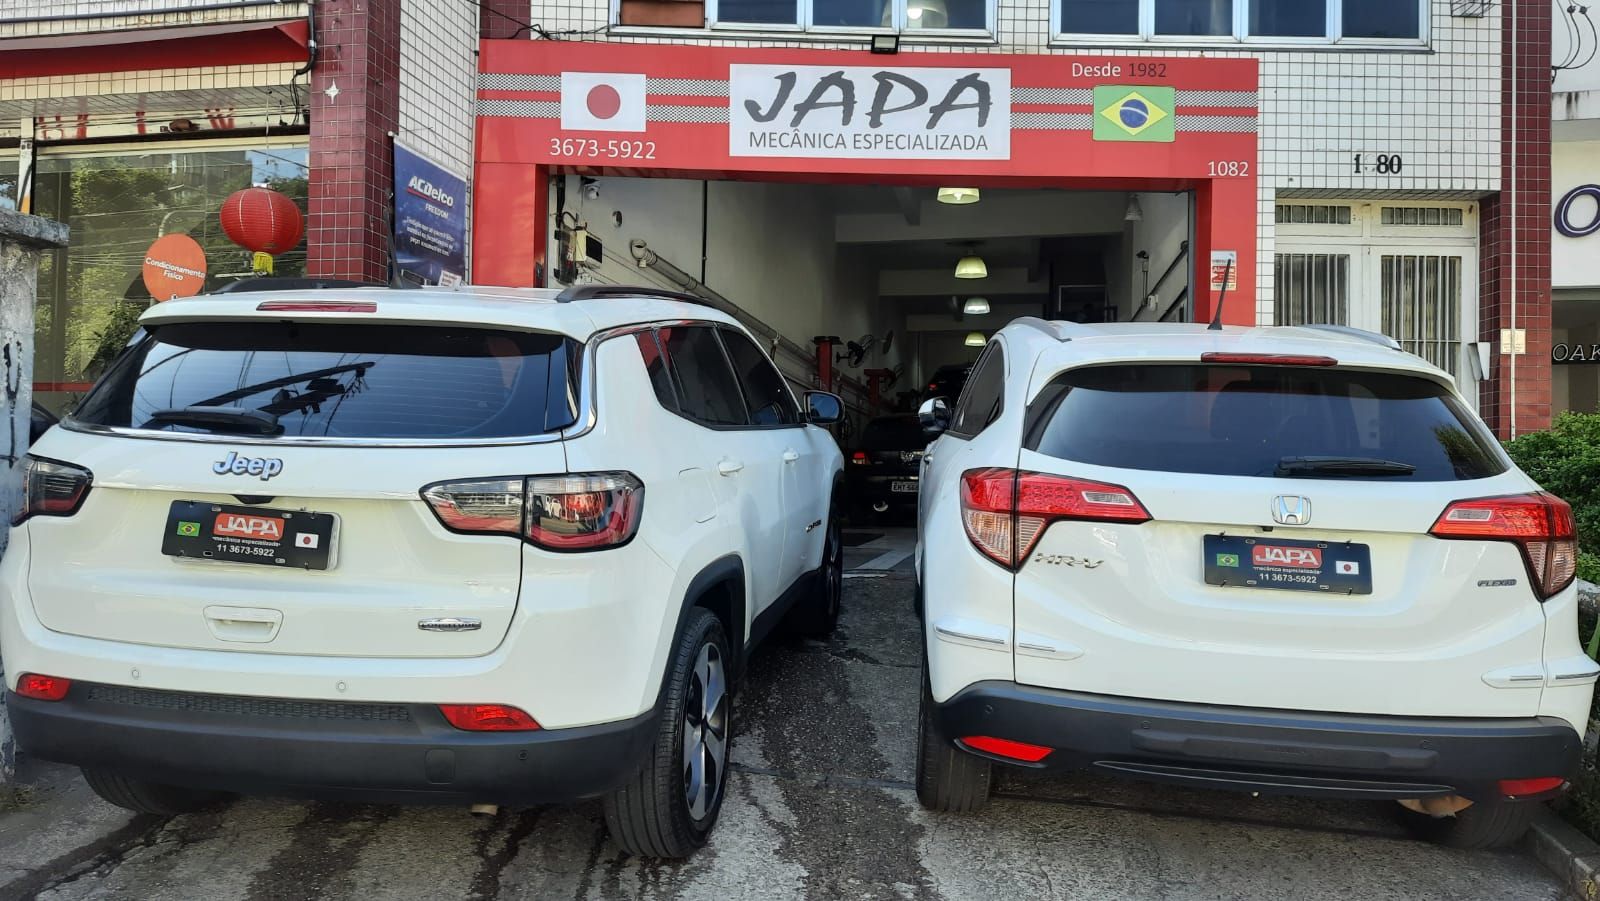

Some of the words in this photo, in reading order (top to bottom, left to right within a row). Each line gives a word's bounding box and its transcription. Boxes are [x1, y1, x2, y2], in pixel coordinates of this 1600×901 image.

[1072, 62, 1121, 77] Desde
[1128, 63, 1167, 77] 1982
[744, 70, 993, 130] JAPA
[550, 138, 656, 159] 3673-5922
[749, 129, 847, 149] MECÂNICA
[853, 133, 988, 150] ESPECIALIZADA
[1207, 161, 1249, 177] 1082
[1354, 153, 1402, 174] 180
[408, 175, 454, 207] ACDelco
[425, 203, 449, 219] FREEDOM
[145, 257, 206, 278] Condicionamento
[213, 451, 283, 481] Jeep
[217, 516, 279, 537] JAPA
[217, 544, 227, 552] 11
[229, 545, 275, 557] 3673-5922
[1034, 552, 1105, 569] HR-V
[1255, 547, 1319, 566] JAPA
[1271, 574, 1317, 584] 3673-5922
